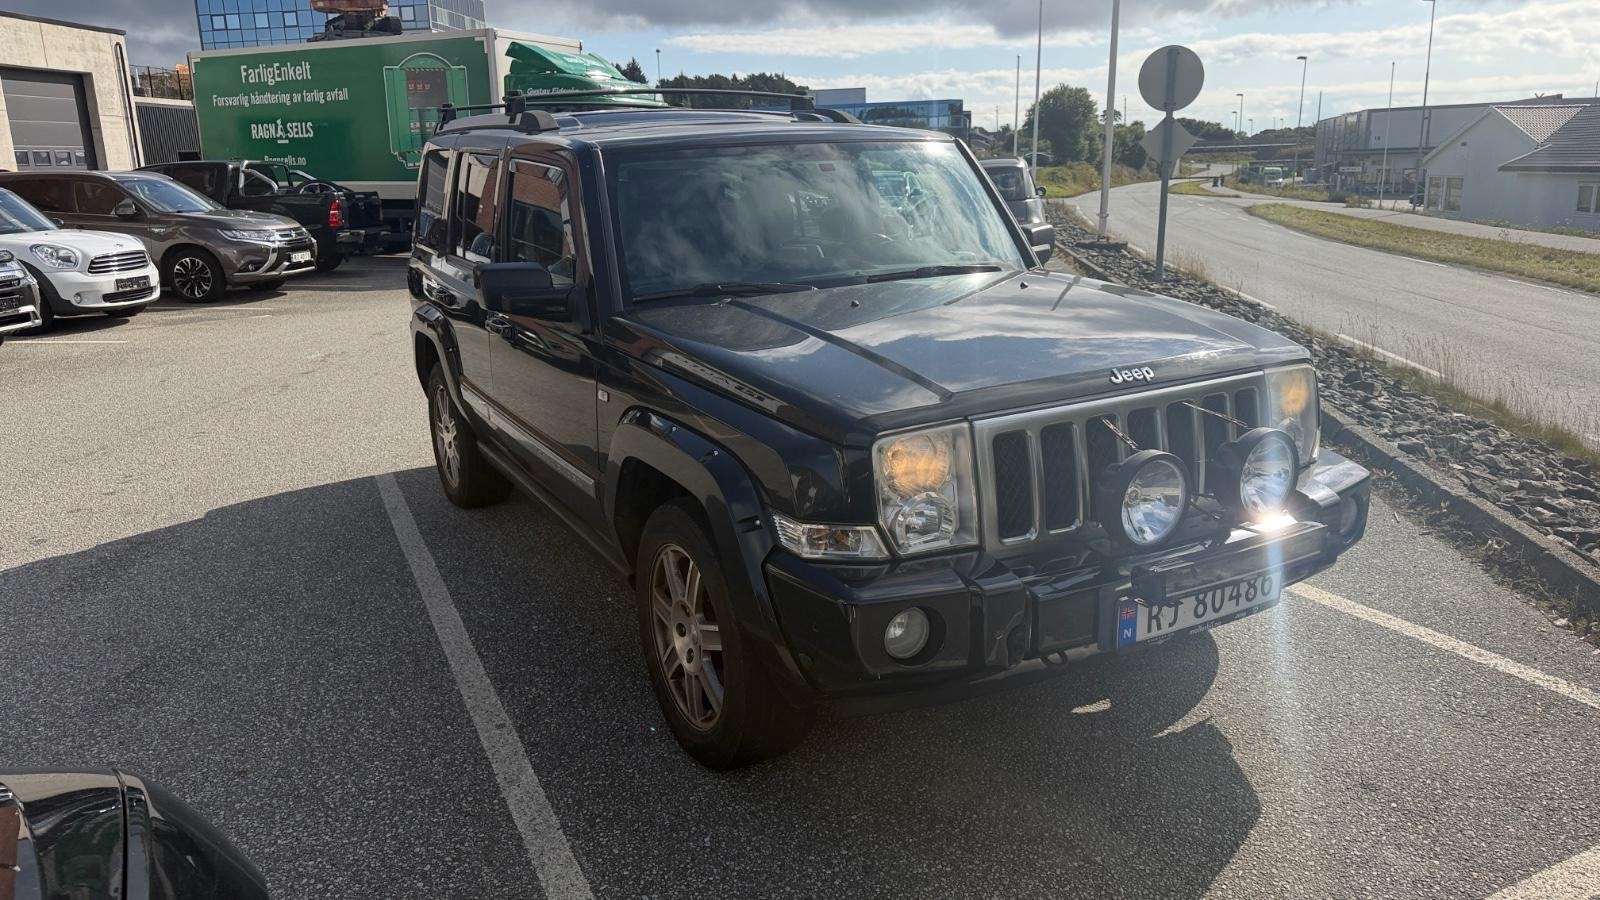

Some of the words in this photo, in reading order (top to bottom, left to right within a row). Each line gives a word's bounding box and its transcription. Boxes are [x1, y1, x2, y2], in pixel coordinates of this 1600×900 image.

[240, 61, 312, 85] FarligEnkelt
[212, 93, 249, 107] Forsvarlig
[250, 91, 291, 105] håndtering
[292, 92, 302, 103] av
[303, 89, 325, 104] farlig
[326, 87, 349, 102] avfall
[1110, 366, 1155, 384] Jeep
[1123, 627, 1132, 639] N
